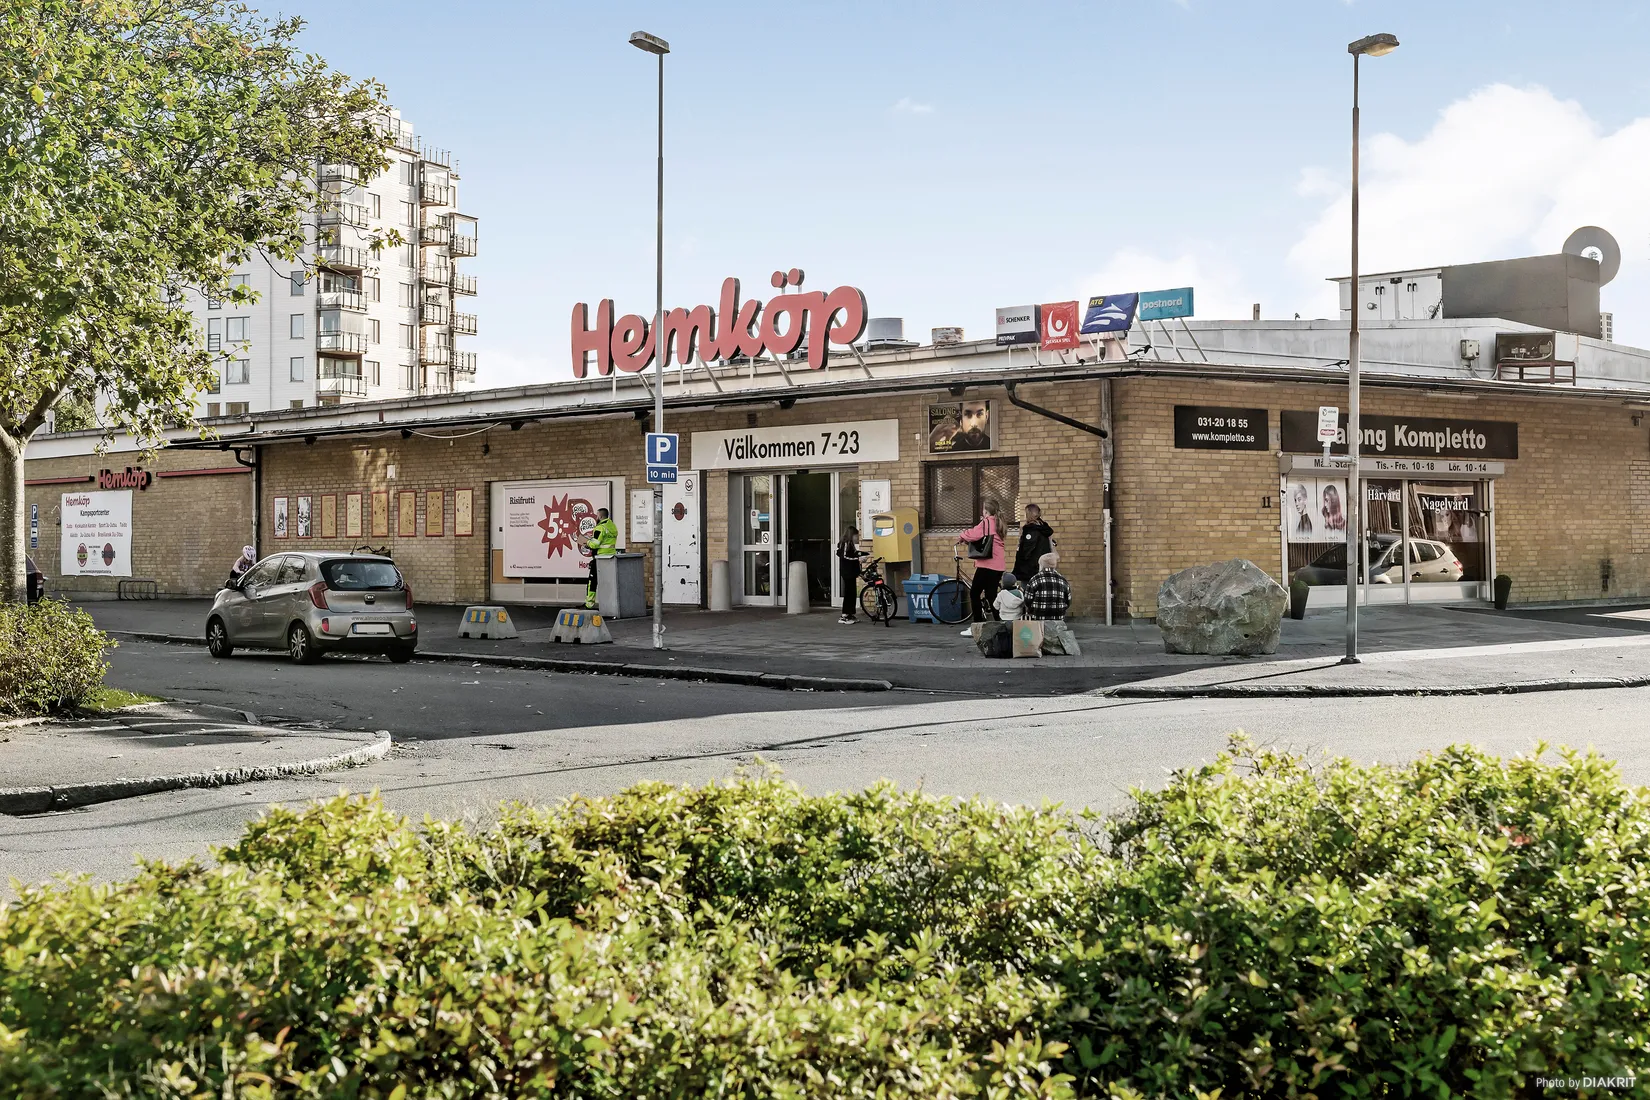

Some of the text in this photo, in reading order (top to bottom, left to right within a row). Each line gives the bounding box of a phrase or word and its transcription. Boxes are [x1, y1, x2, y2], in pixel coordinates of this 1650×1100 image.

[1089, 298, 1104, 306] ATG
[1142, 297, 1183, 311] postnord
[571, 268, 868, 379] Hemköp
[1005, 315, 1031, 324] SCHENKER
[931, 406, 956, 416] SALONG
[1197, 417, 1249, 428] 031-20 18 55
[1191, 432, 1255, 444] www.kompletto.se
[1394, 424, 1487, 453] Kompletto
[656, 437, 671, 462] P
[724, 430, 860, 461] Välkommen 7-23
[1376, 461, 1389, 470] Tis.
[1394, 462, 1408, 470] Fre.
[1412, 462, 1420, 470] 10
[1448, 463, 1462, 471] Lör.
[1465, 464, 1474, 472] 10
[1479, 464, 1487, 472] 14
[98, 467, 149, 490] Hemköp
[650, 470, 675, 479] 10 min
[509, 495, 535, 505] Risifrutti
[1367, 488, 1401, 501] Hårvård
[65, 495, 91, 508] Hemköp
[1261, 496, 1272, 508] 11
[1421, 496, 1469, 514] Nagelvård
[32, 505, 37, 519] P
